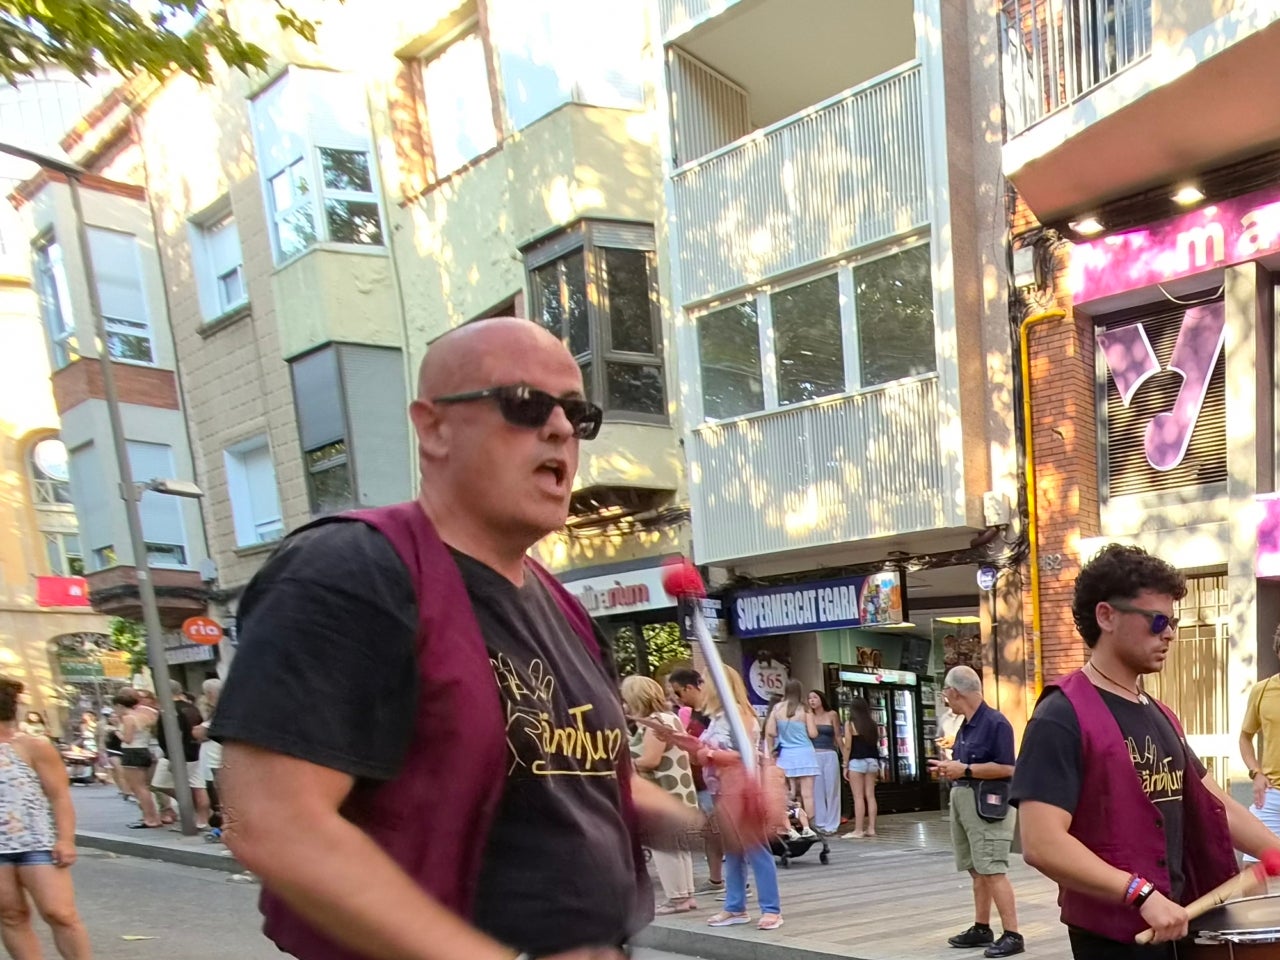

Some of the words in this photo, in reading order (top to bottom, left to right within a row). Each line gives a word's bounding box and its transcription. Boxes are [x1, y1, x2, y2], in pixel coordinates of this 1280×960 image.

[737, 590, 819, 632] SUPERMERCAT
[819, 584, 859, 622] EGARA
[190, 620, 220, 636] ria
[757, 672, 784, 689] 365
